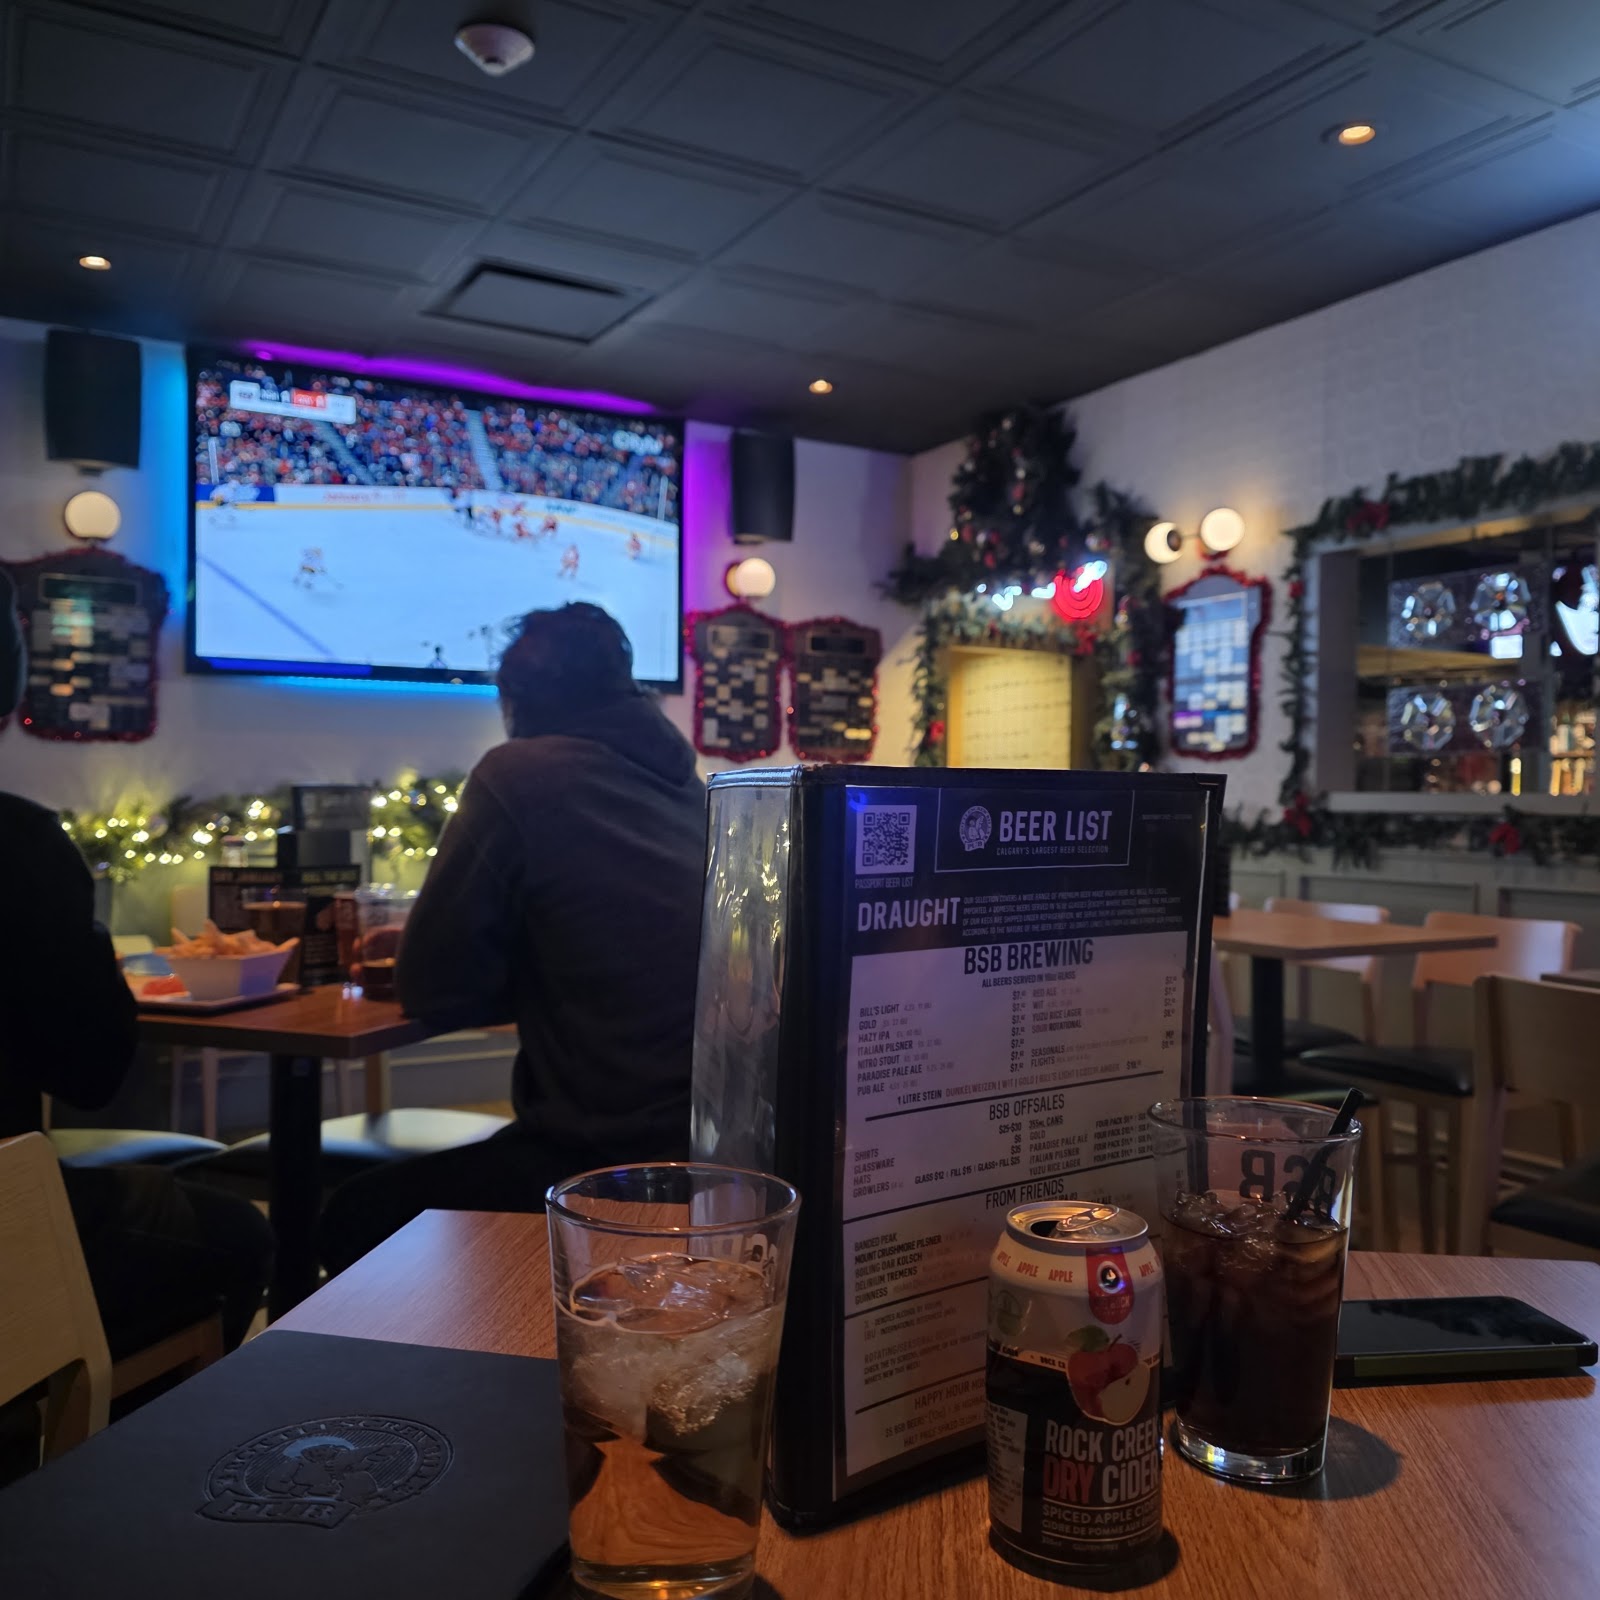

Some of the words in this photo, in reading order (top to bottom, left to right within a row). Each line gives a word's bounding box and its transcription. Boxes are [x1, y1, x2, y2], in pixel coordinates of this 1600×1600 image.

[999, 811, 1058, 843] BEER
[1065, 810, 1114, 842] LIST
[997, 847, 1030, 856] CALGARY'S
[1032, 846, 1058, 855] LARGEST
[1077, 844, 1109, 854] SELECTION
[855, 878, 885, 889] PASSPORT
[885, 877, 901, 888] BEER
[901, 876, 914, 888] LIST
[858, 897, 961, 932] DRAUGHT
[964, 945, 1003, 975] BSB
[1007, 938, 1094, 972] BREWING
[982, 978, 992, 989] ALL
[993, 976, 1013, 987] BEERS
[1012, 974, 1036, 985] SERVED
[1036, 973, 1044, 982] IN
[1046, 986, 1057, 997] ALE
[859, 1005, 880, 1018] BILL'S
[880, 1003, 900, 1015] LIGHT
[1063, 1008, 1082, 1018] LAGER
[859, 1019, 877, 1031] GOLD
[858, 1031, 877, 1044] HAZY
[878, 1030, 890, 1041] IPA
[857, 1044, 884, 1057] ITALIAN
[885, 1039, 914, 1053] PILSNER
[1031, 1044, 1065, 1058] SEASONALS
[857, 1057, 878, 1070] NITRO
[879, 1054, 900, 1067] STOUT
[1030, 1055, 1056, 1069] FLIGHTS
[857, 1069, 891, 1083] PARADISE
[891, 1065, 909, 1077] PALE
[909, 1063, 923, 1074] ALE
[857, 1085, 871, 1097] PUB
[872, 1082, 885, 1094] ALE
[902, 1092, 921, 1105] LITRE
[922, 1089, 943, 1102] STEIN
[945, 1080, 997, 1098] DUNKELWEIZEN
[989, 1102, 1010, 1121] BSB
[1013, 1093, 1065, 1117] OFFSALES
[1046, 1115, 1064, 1127] CANS
[1095, 1119, 1109, 1129] FOUR
[1029, 1130, 1046, 1141] GOLD
[1029, 1139, 1060, 1153] PARADISE
[1061, 1135, 1076, 1147] PALE
[1077, 1133, 1088, 1144] ALE
[855, 1148, 879, 1162] SHIRTS
[1029, 1152, 1054, 1165] ITALIAN
[1054, 1147, 1080, 1159] PILSNER
[854, 1157, 896, 1175] GLASSWARE
[914, 1173, 934, 1185] GLASS
[934, 1172, 945, 1182] $12
[950, 1168, 962, 1178] FILL
[962, 1165, 973, 1176] $15
[999, 1158, 1010, 1168] FILL
[1029, 1166, 1046, 1176] YUZU
[1062, 1158, 1081, 1169] LAGER
[853, 1174, 872, 1186] HATS
[852, 1182, 890, 1199] GROWLERS
[985, 1188, 1016, 1211] FROM
[1020, 1178, 1065, 1203] FRIENDS
[854, 1250, 877, 1265] MOUNT
[877, 1240, 916, 1260] CRUSHMORE
[916, 1234, 942, 1249] PILSNER
[855, 1236, 880, 1252] BANDED
[880, 1232, 898, 1246] PEAK
[855, 1263, 881, 1279] BOILING
[896, 1252, 923, 1267] KOLSCH
[996, 1250, 1012, 1268] APPLE
[1016, 1260, 1040, 1278] APPLE
[1048, 1268, 1074, 1283] APPLE
[1138, 1261, 1155, 1278] APPLE
[855, 1273, 886, 1292] DELIRIUM
[886, 1266, 918, 1283] TREMENS
[854, 1286, 889, 1305] GUINNESS
[914, 1388, 944, 1410] HAPPY
[945, 1380, 970, 1399] HOUR
[1045, 1419, 1104, 1463] ROCK
[1043, 1455, 1095, 1505] DRY
[1094, 1508, 1132, 1525] APPLE
[1042, 1519, 1071, 1533] CIDRE
[1072, 1526, 1086, 1536] DE
[1088, 1525, 1124, 1536] POMME
